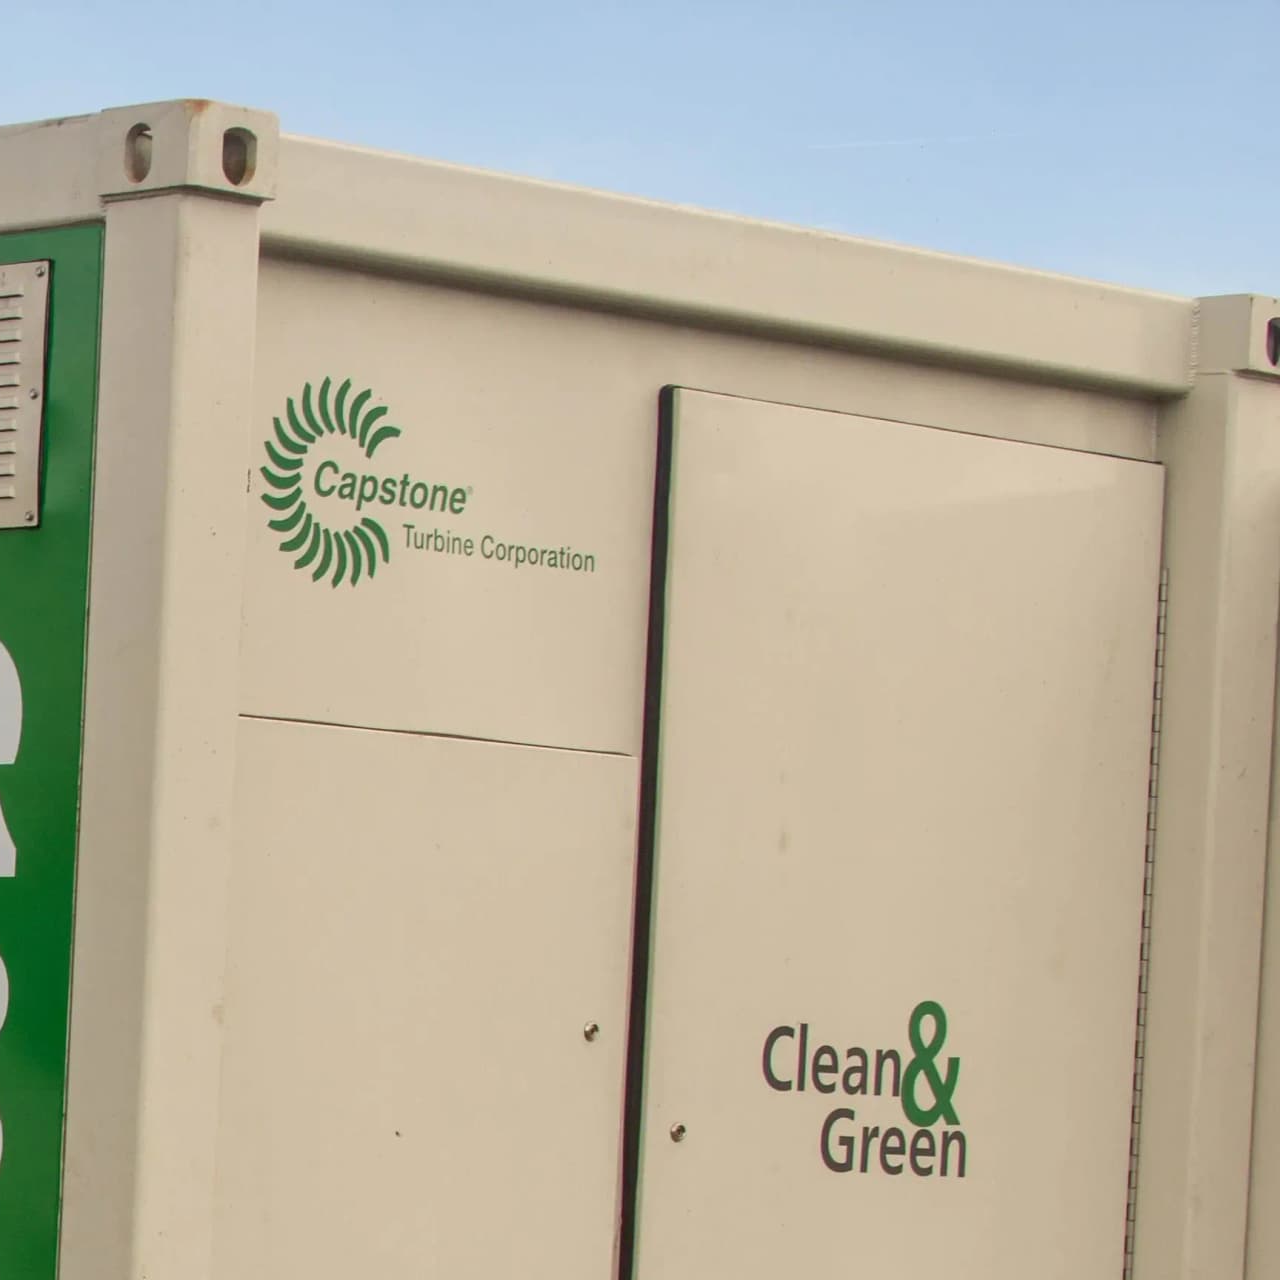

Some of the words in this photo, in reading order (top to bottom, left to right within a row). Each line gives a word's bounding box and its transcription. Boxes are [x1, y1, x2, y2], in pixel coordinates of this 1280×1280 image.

[313, 460, 468, 514] Capstone
[402, 524, 474, 556] Turbine
[480, 535, 596, 573] Corporation
[820, 1108, 967, 1178] Green
